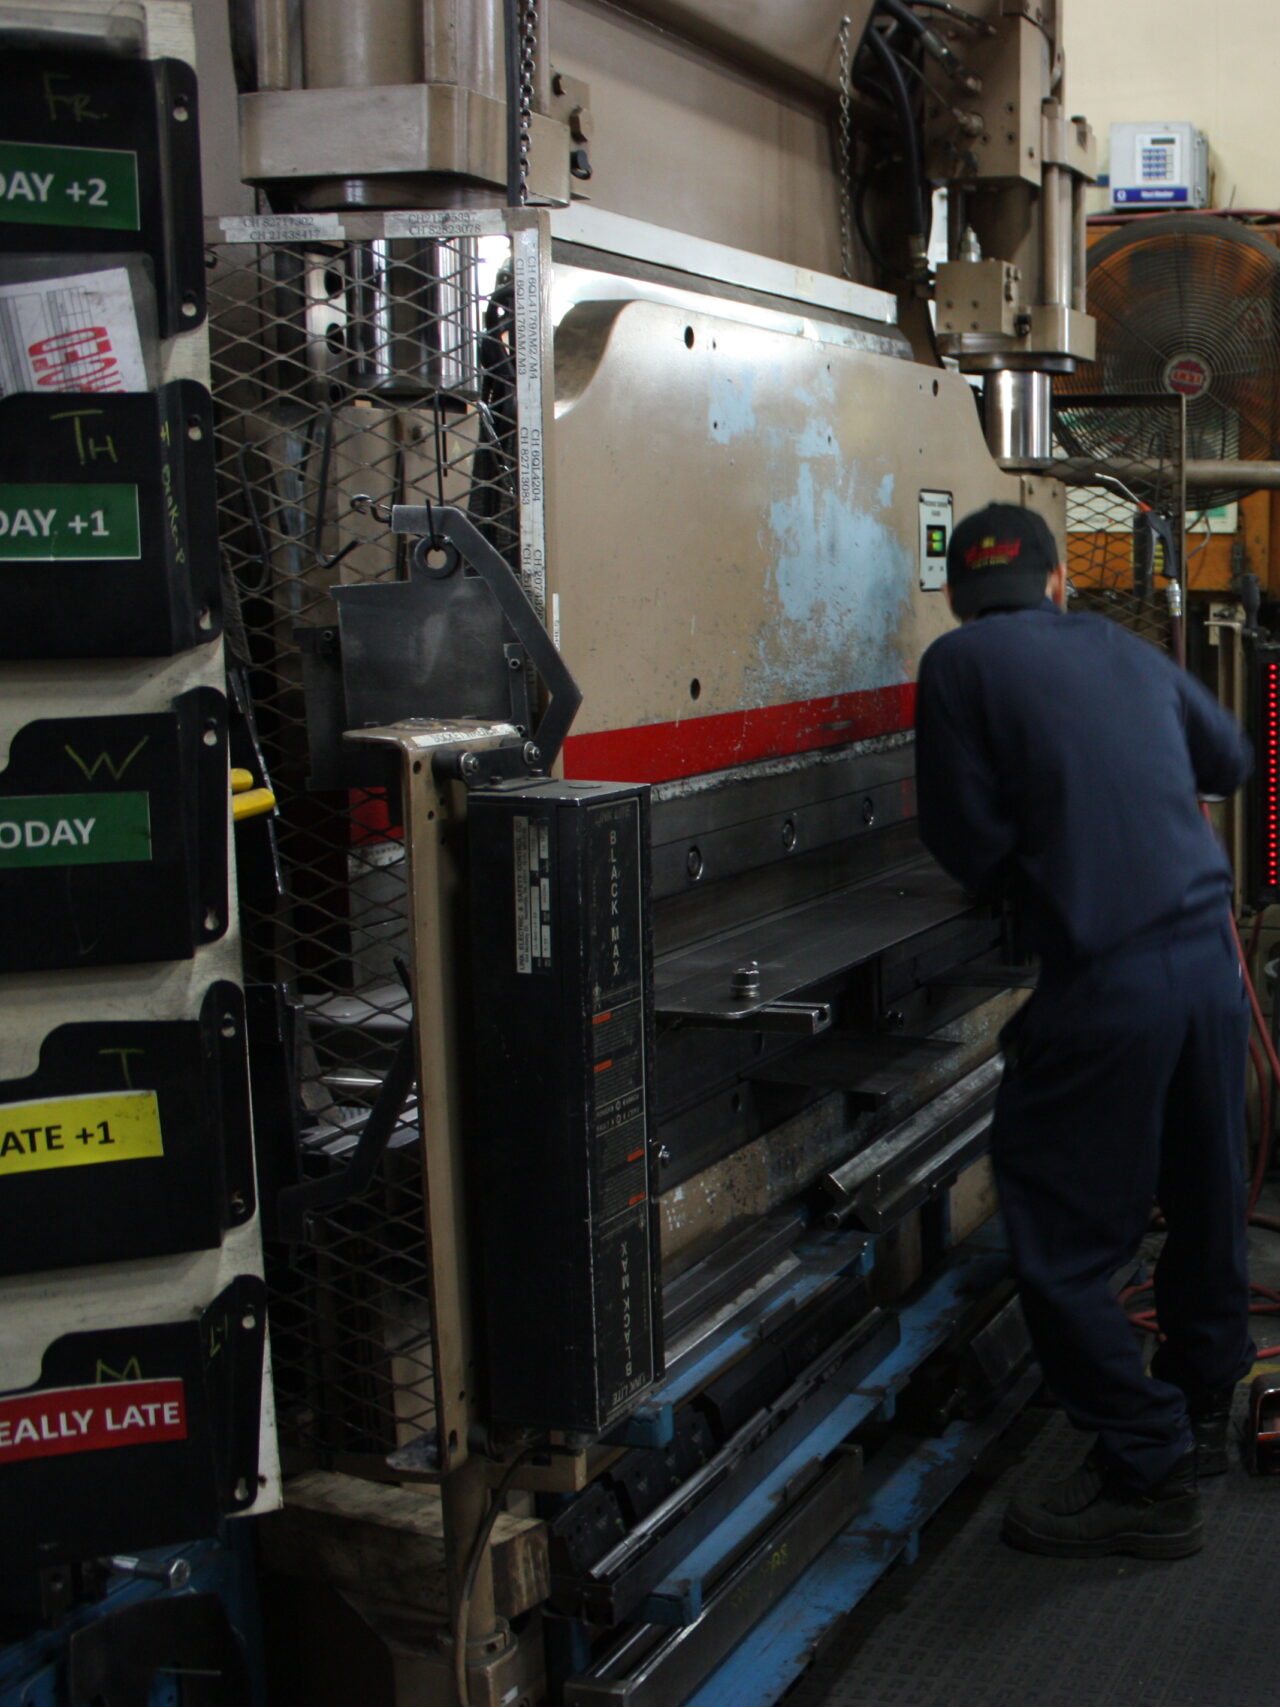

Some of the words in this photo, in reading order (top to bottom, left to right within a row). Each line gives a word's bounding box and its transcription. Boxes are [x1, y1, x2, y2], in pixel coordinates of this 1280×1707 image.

[65, 178, 109, 207] +2
[516, 258, 525, 275] CH
[528, 256, 537, 273] CH
[521, 427, 530, 445] CH
[531, 429, 540, 446] CH
[68, 510, 110, 536] +1
[534, 549, 543, 566] CH
[64, 735, 149, 782] W
[609, 829, 619, 915] BLACK
[611, 925, 620, 976] MAX
[75, 1121, 115, 1146] +1
[620, 1241, 630, 1290] MAX
[623, 1296, 632, 1376] BLACK
[105, 1401, 181, 1432] LATE
